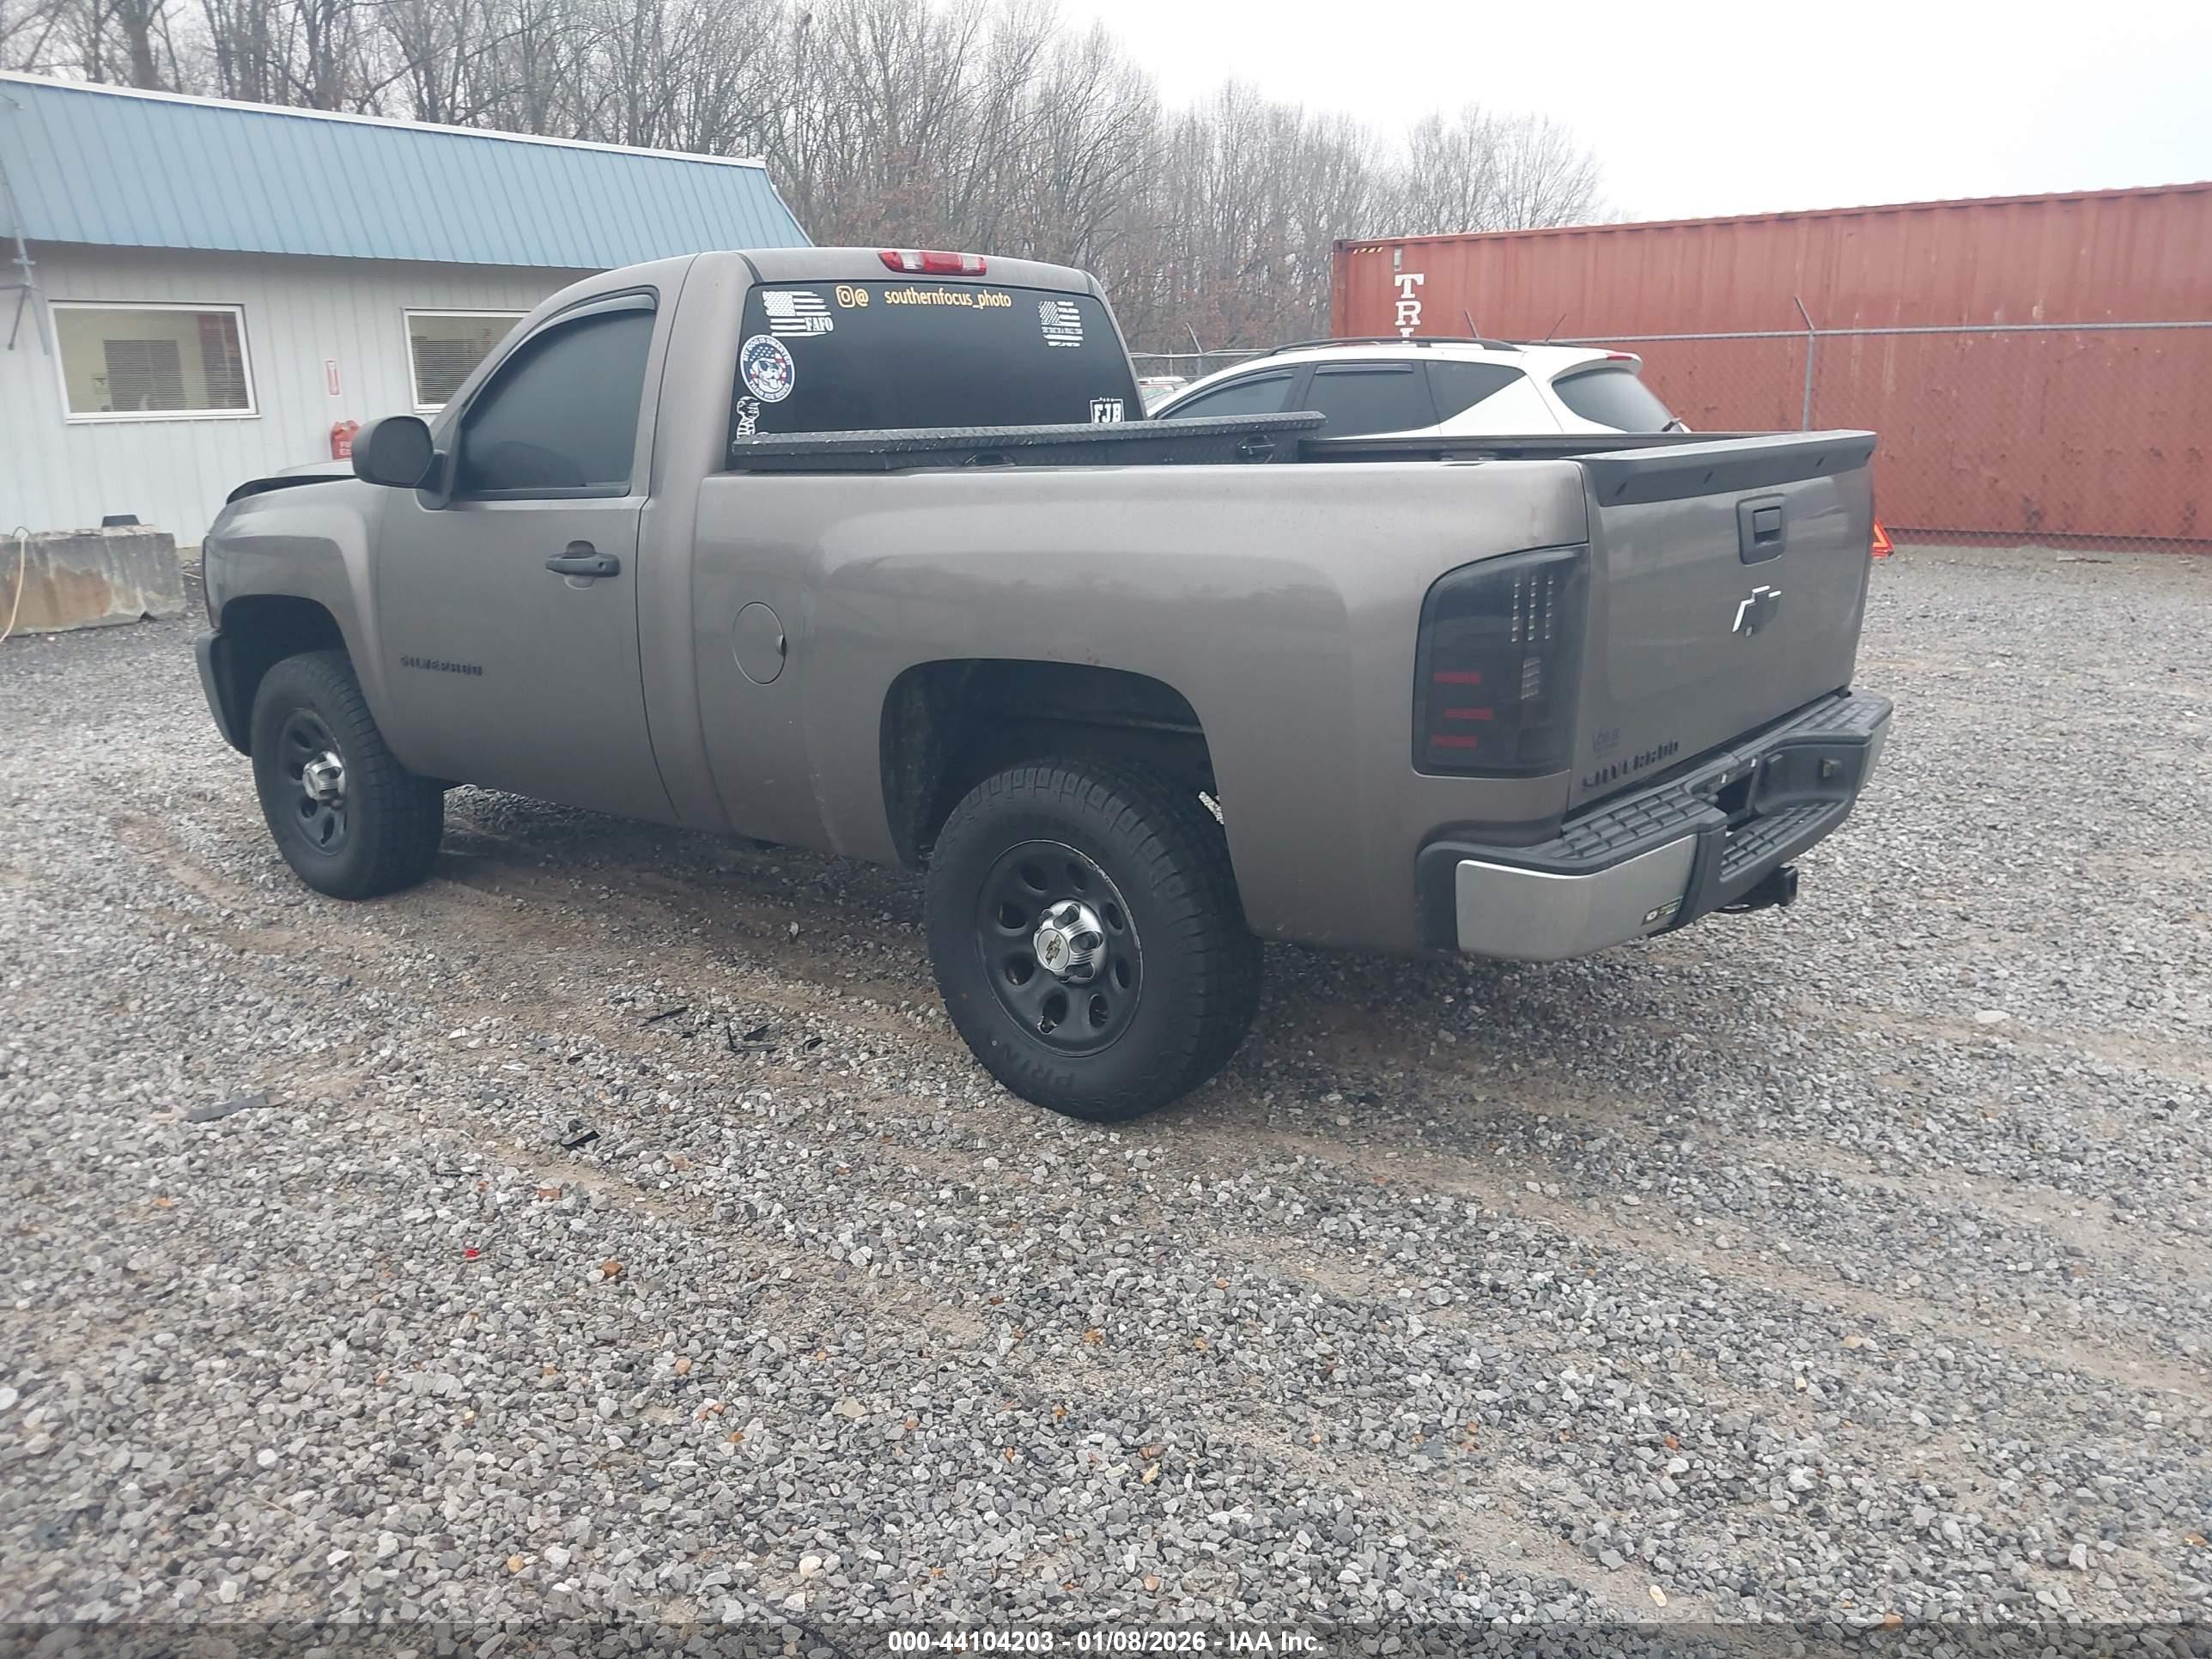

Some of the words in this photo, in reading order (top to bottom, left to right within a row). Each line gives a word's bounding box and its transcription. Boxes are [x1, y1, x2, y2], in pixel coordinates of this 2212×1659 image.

[884, 287, 1012, 309] southernfocus_photo
[805, 316, 834, 331] FAFO
[1093, 403, 1121, 423] FJB
